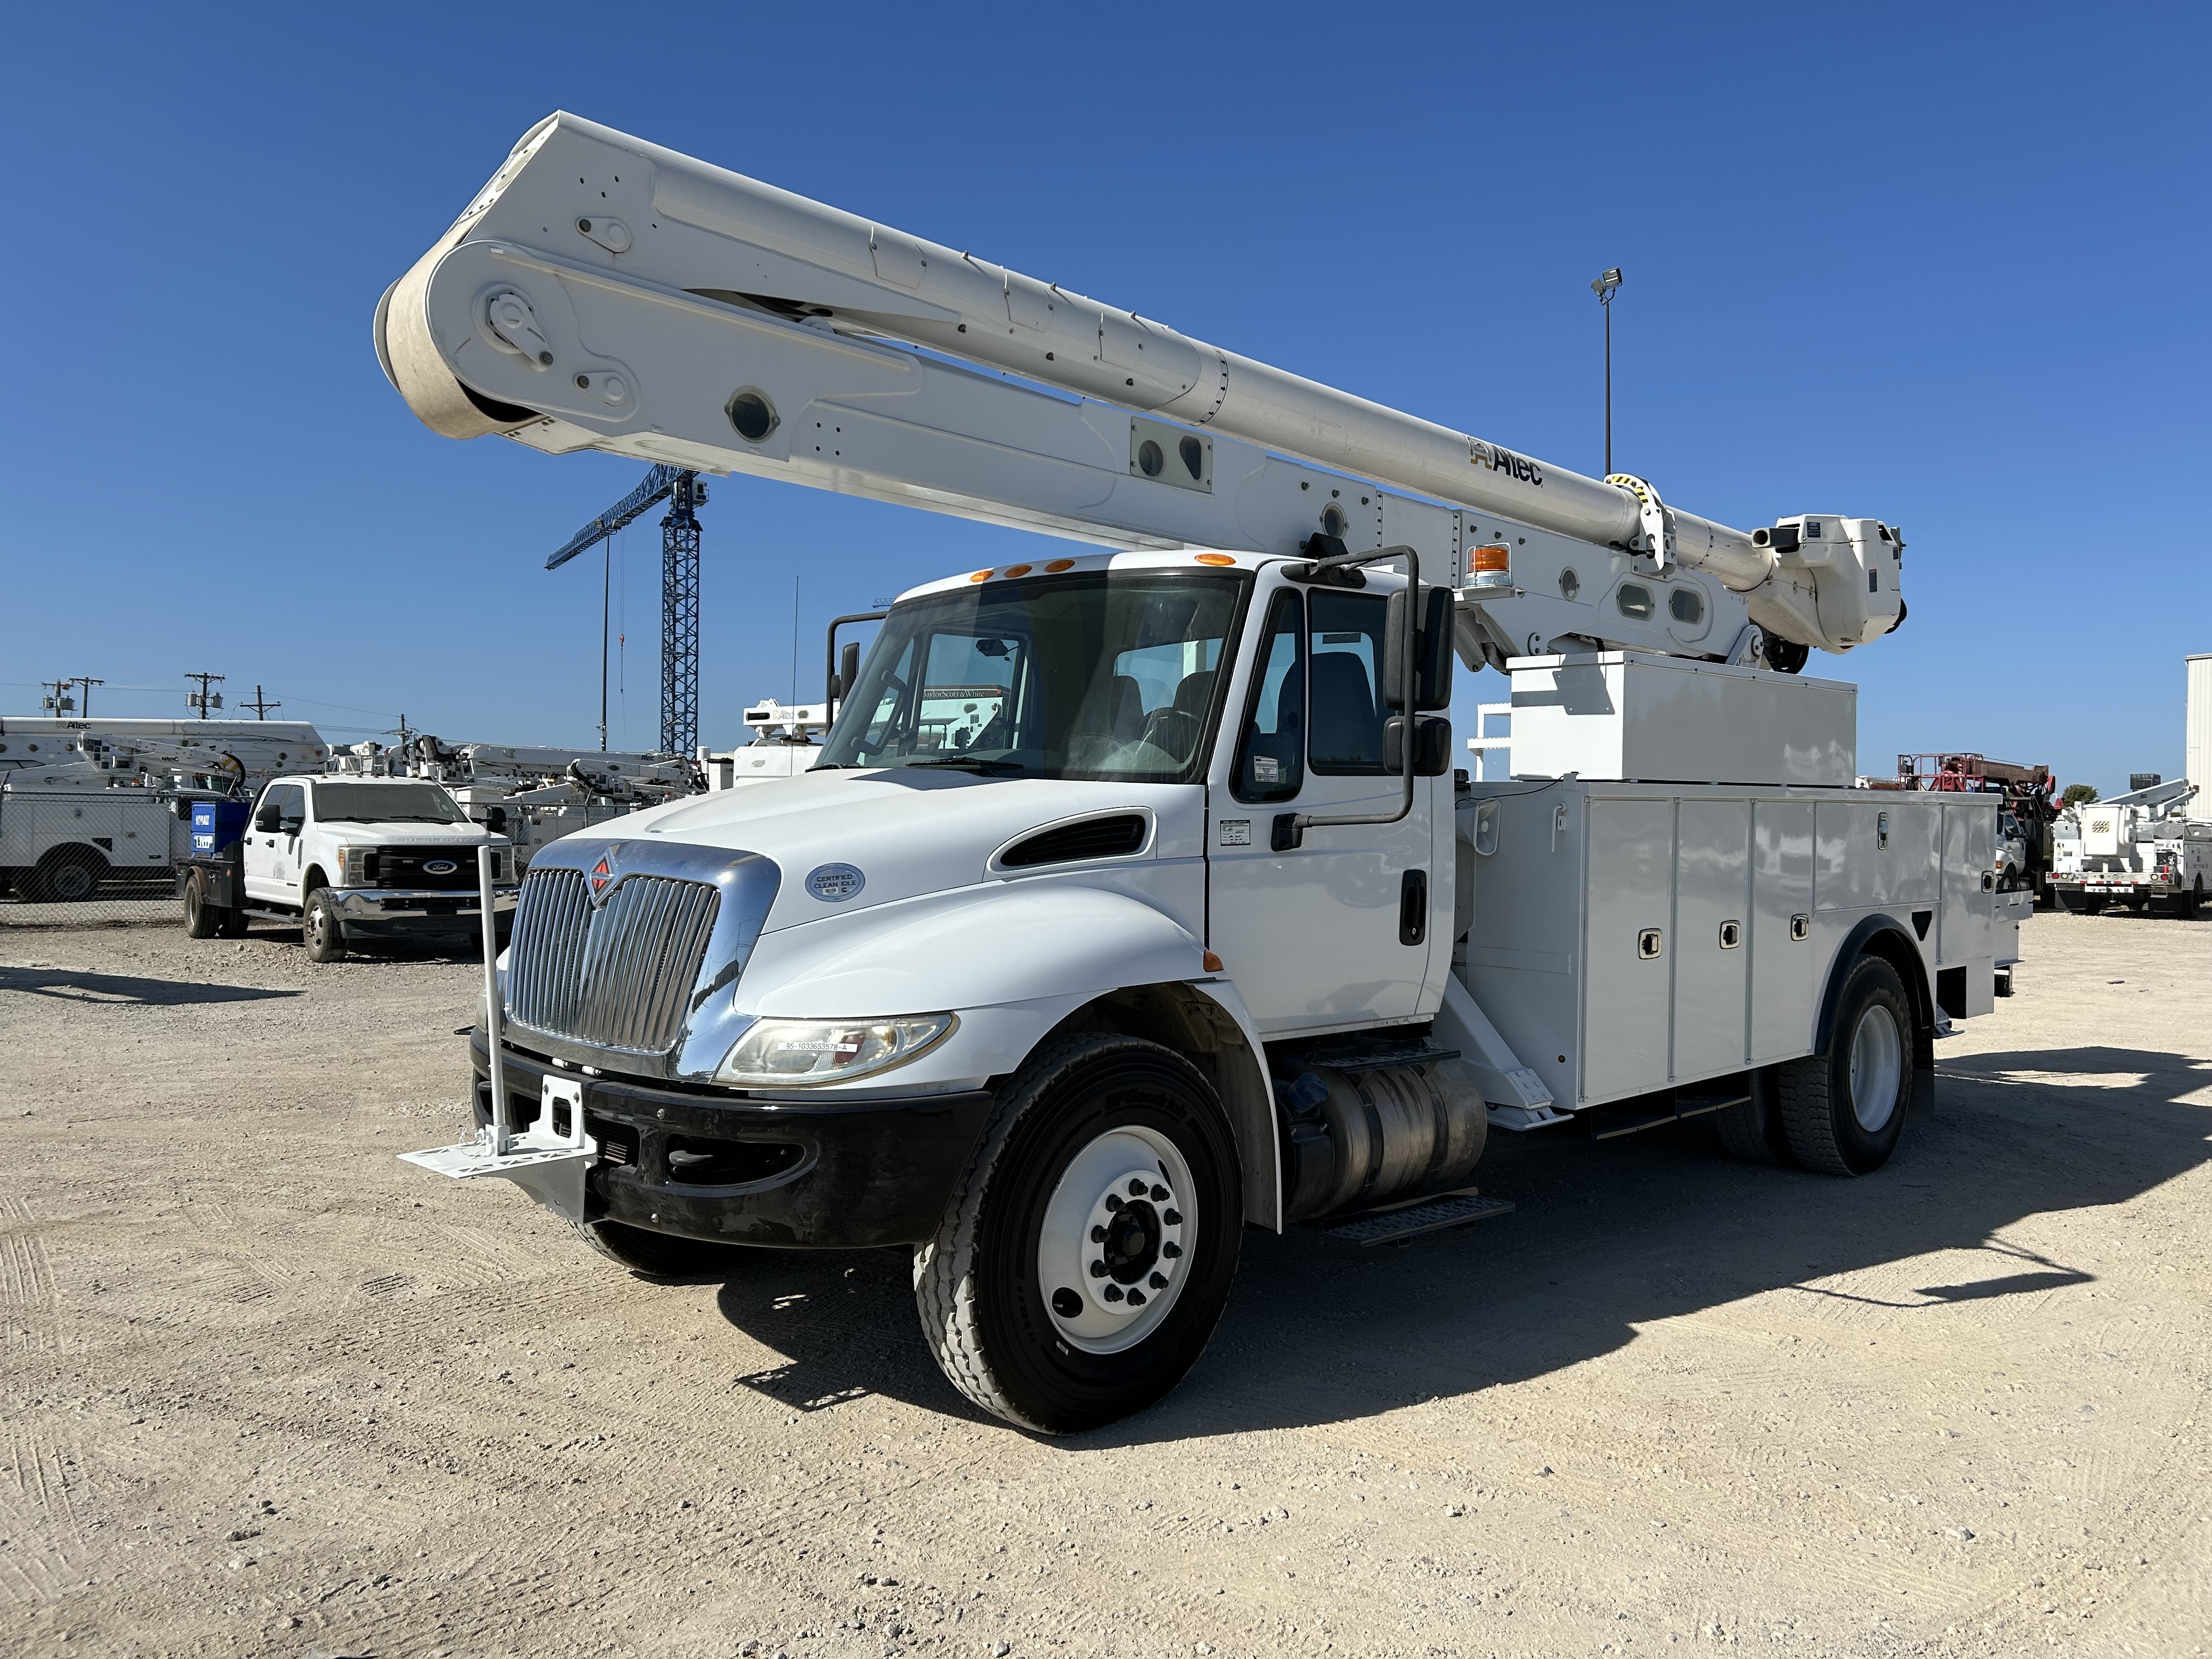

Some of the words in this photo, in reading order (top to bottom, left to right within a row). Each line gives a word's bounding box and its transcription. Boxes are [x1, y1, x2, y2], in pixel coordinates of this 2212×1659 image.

[1492, 444, 1543, 486] Altec
[67, 721, 91, 729] Altec
[816, 874, 853, 882] CERTIFIED
[786, 1042, 847, 1051] 95-1033653578-A
